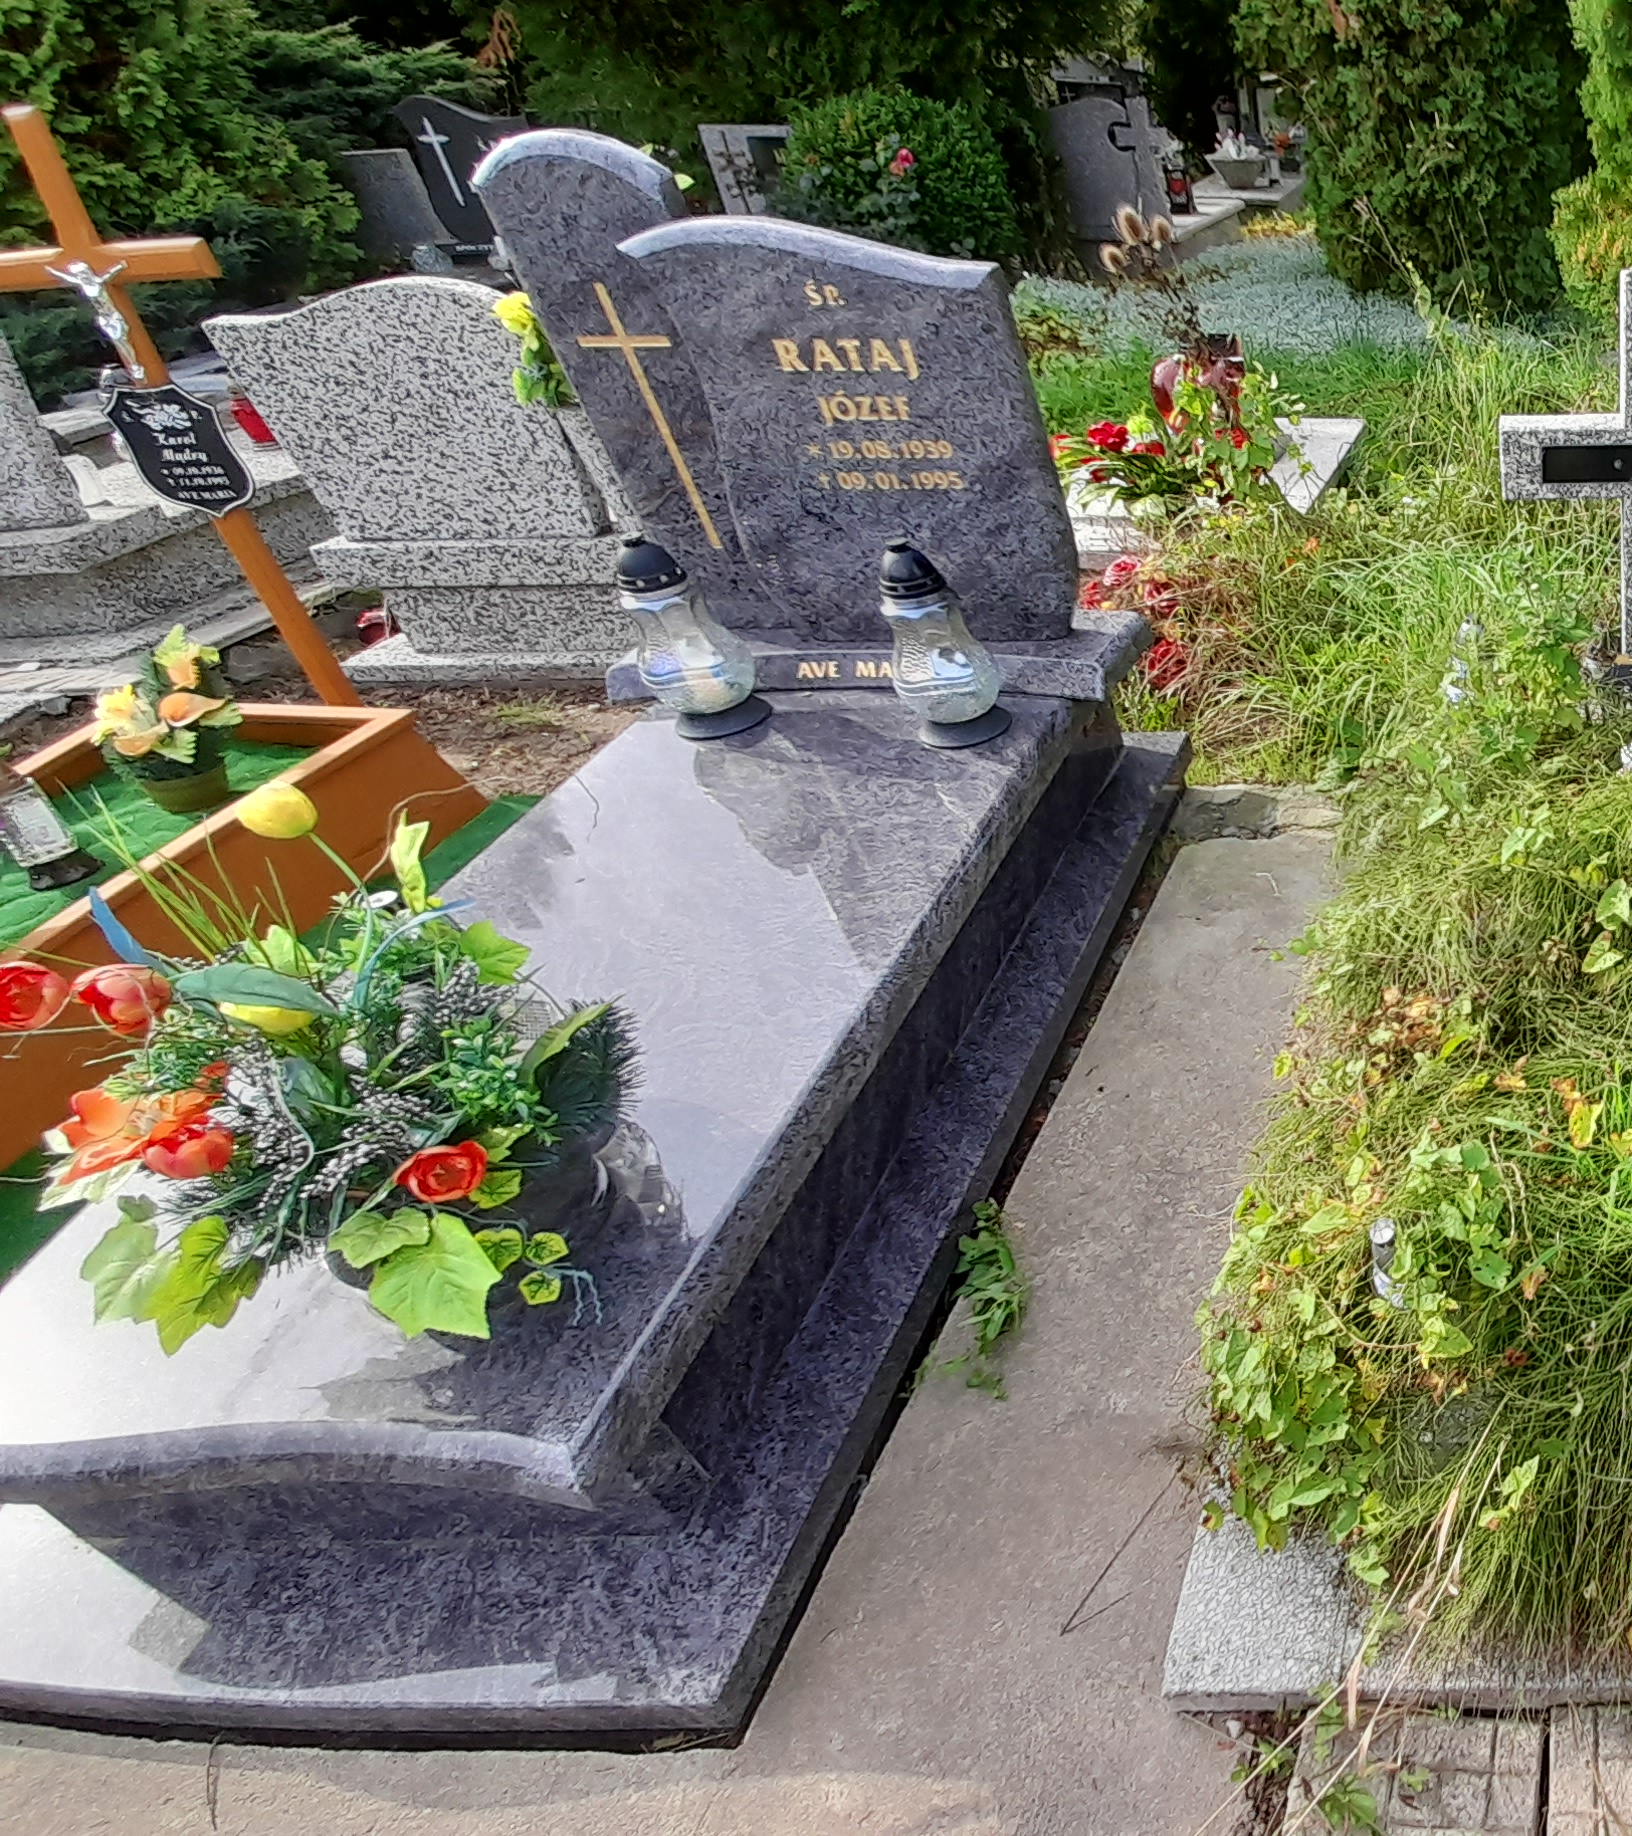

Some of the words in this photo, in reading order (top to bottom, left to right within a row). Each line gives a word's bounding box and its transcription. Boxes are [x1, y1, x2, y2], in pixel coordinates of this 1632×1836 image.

[772, 338, 920, 380] RATAJ
[816, 389, 910, 427] JÓZEF
[152, 431, 197, 446] Karol
[827, 440, 953, 460] 19.08.1939
[836, 471, 965, 491] 09.01.1995
[796, 660, 841, 679] AVE
